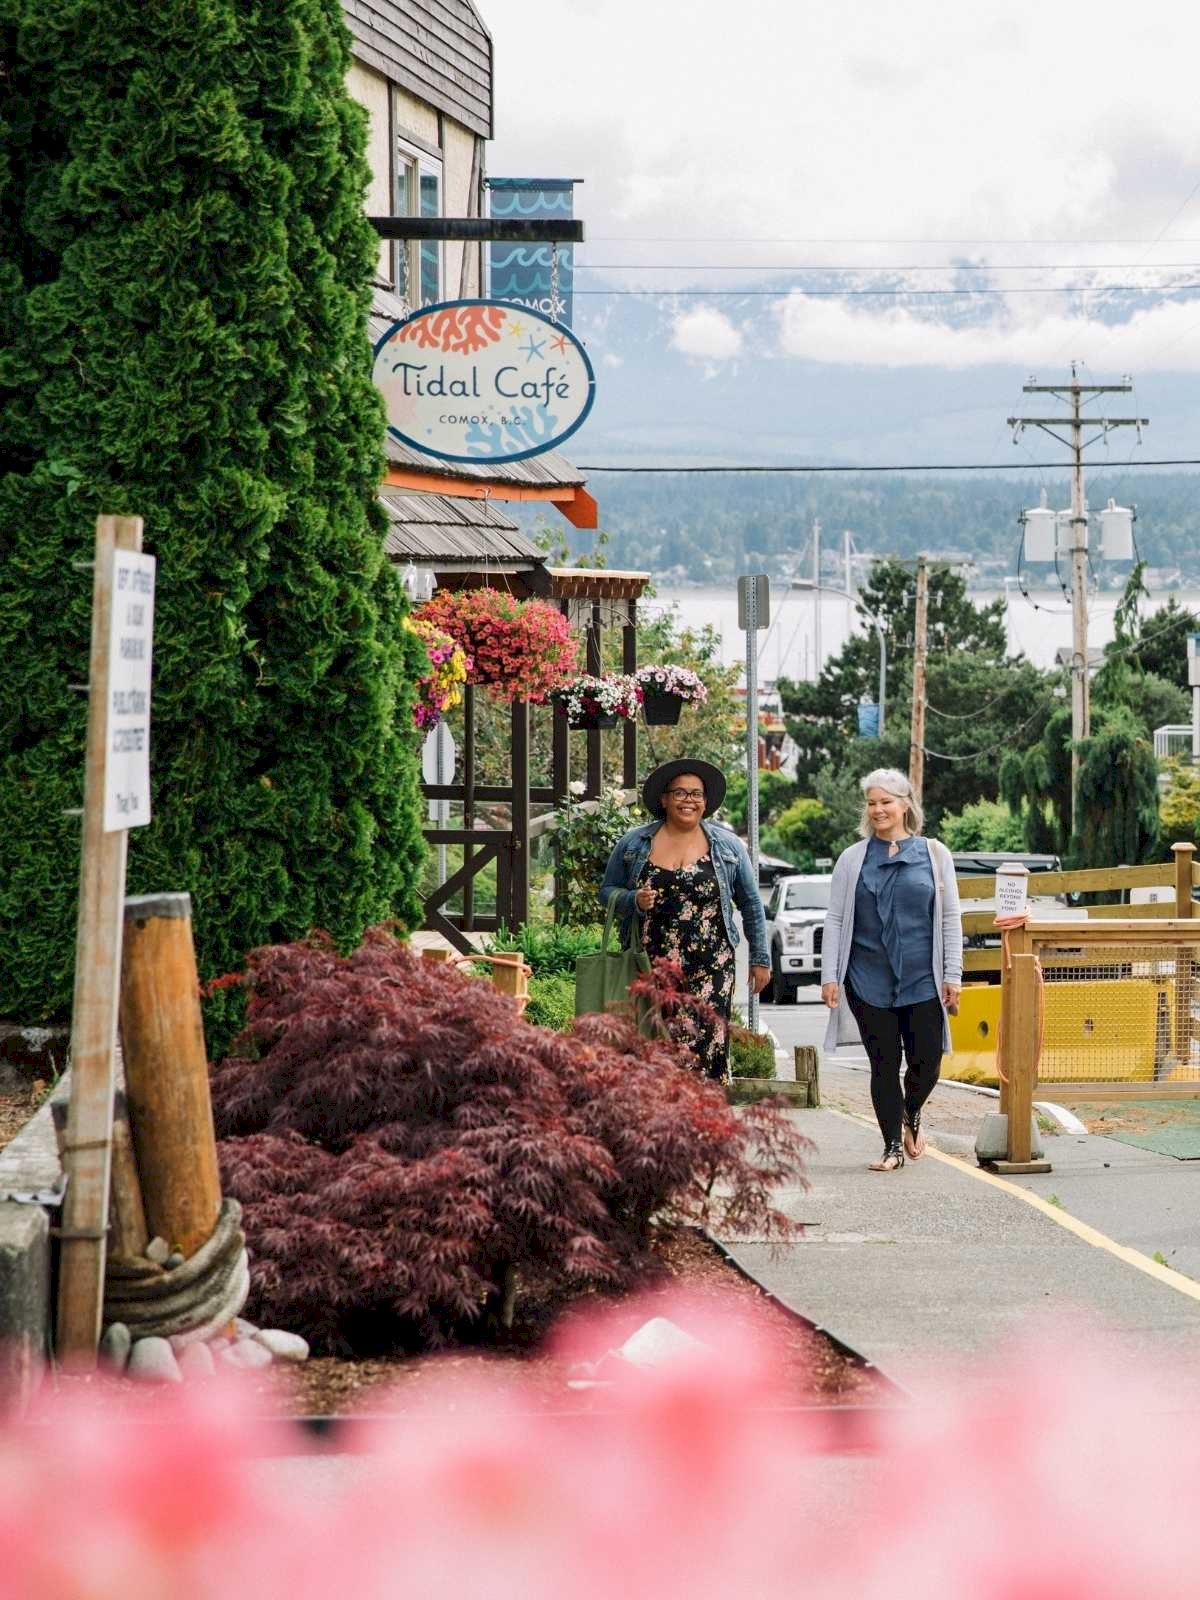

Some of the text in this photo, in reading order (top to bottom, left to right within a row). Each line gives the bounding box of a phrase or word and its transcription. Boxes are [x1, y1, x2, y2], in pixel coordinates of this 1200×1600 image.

[499, 297, 567, 314] MOX
[392, 362, 570, 408] Tidal Café
[438, 414, 526, 427] COMOX, B.C.
